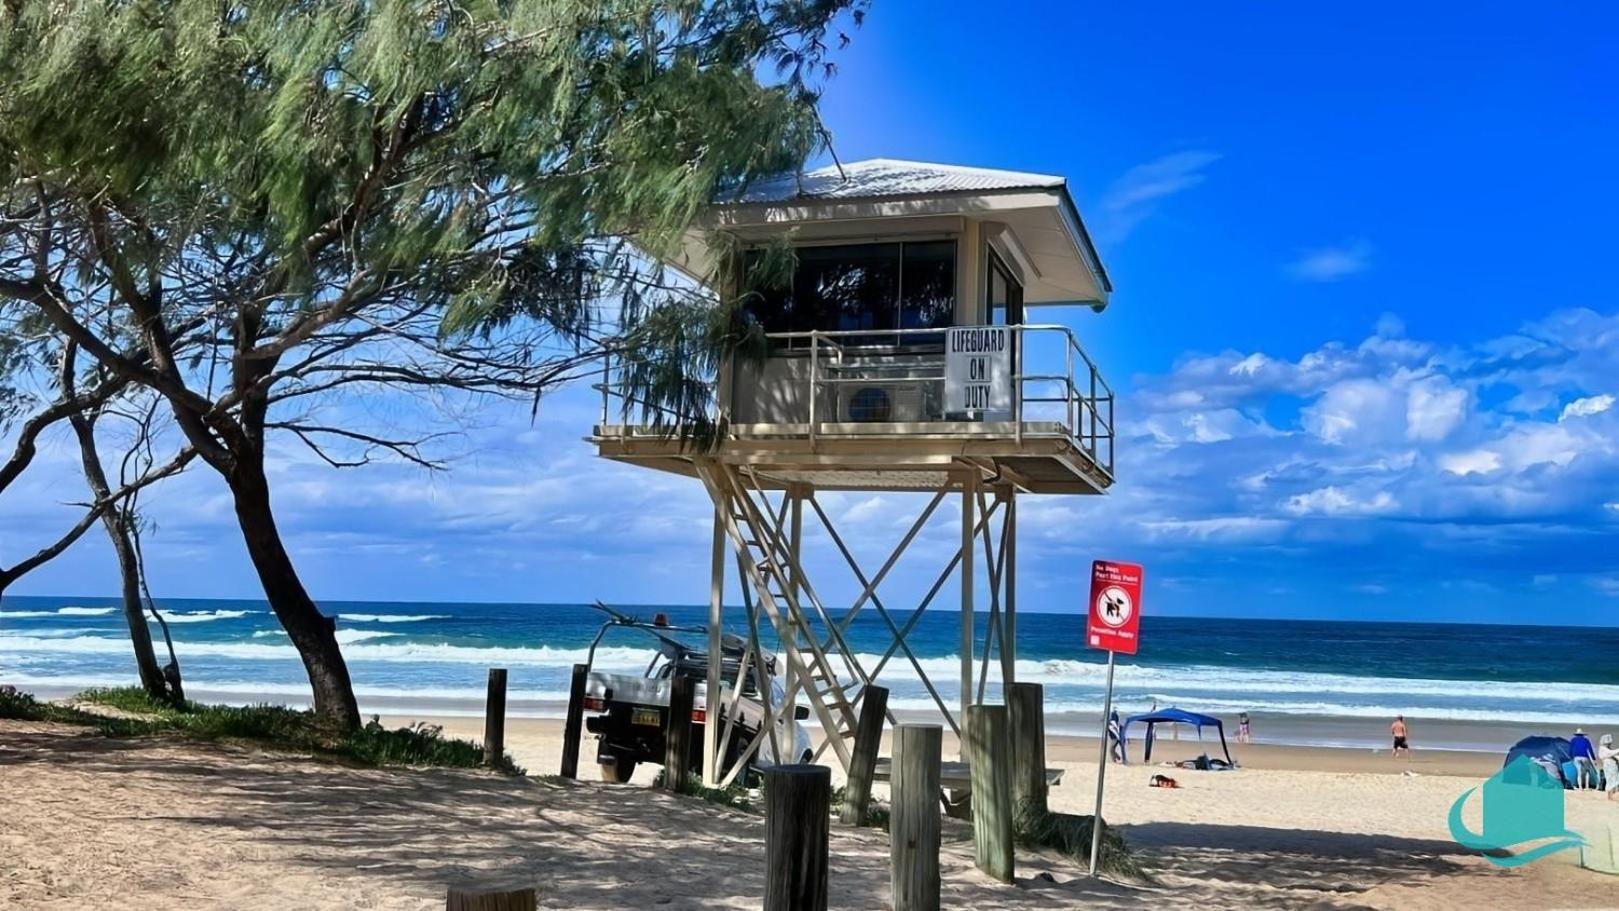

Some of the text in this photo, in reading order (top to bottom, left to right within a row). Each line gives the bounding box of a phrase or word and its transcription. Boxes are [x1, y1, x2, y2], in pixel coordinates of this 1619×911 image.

[952, 329, 1005, 352] LIFEGUARD
[970, 358, 985, 380] ON
[965, 385, 991, 408] DUTY
